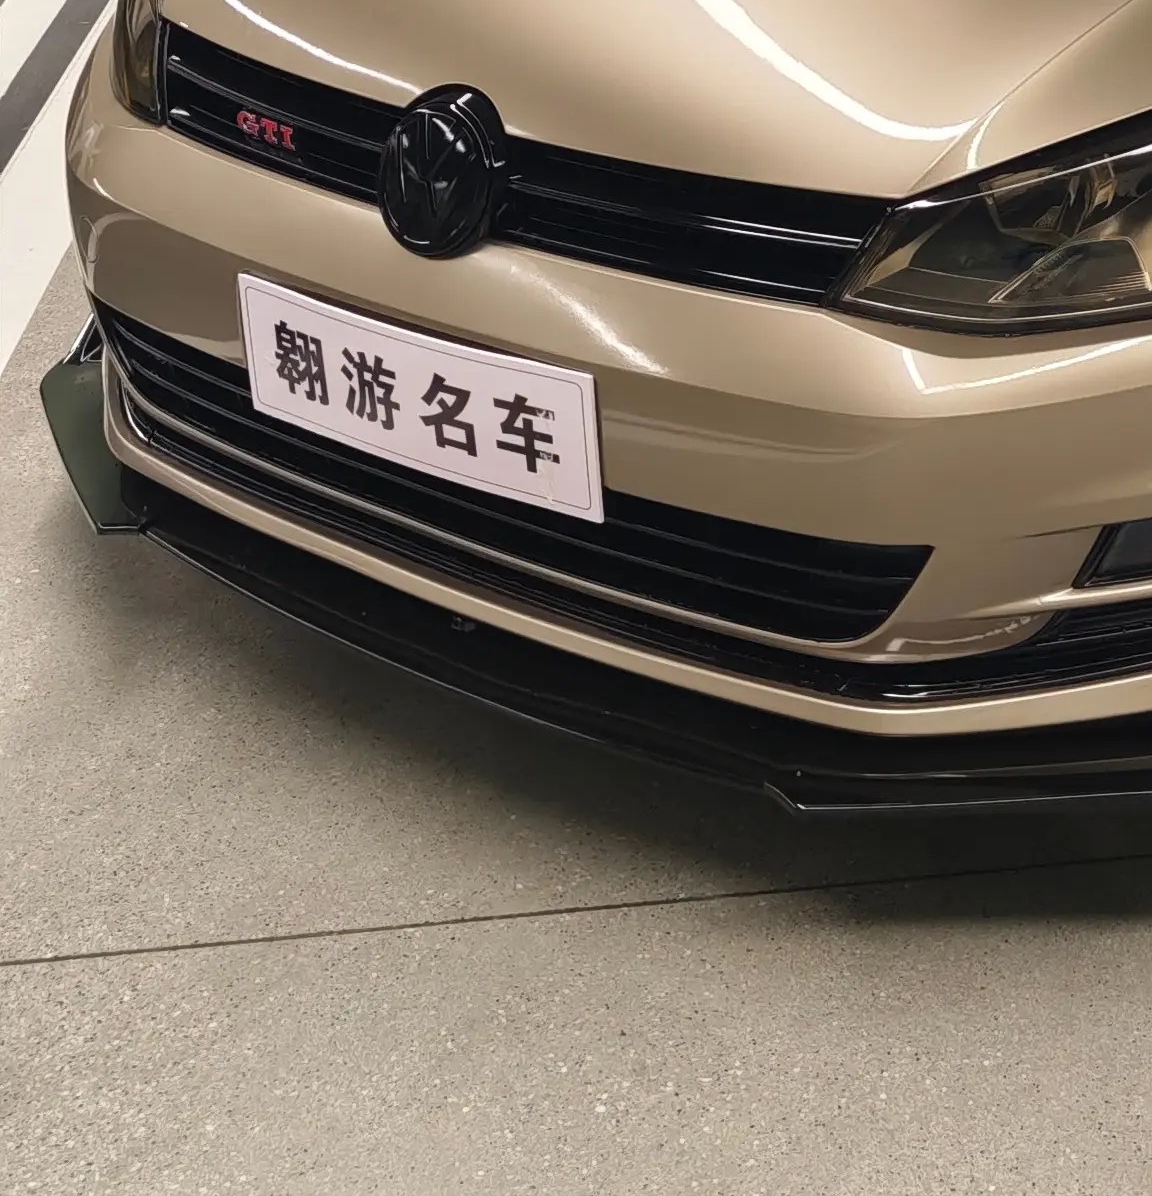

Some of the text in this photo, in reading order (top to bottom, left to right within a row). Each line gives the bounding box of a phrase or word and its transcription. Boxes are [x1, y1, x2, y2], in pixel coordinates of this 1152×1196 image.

[236, 110, 296, 152] GTI
[273, 319, 561, 474] 翱游名车
